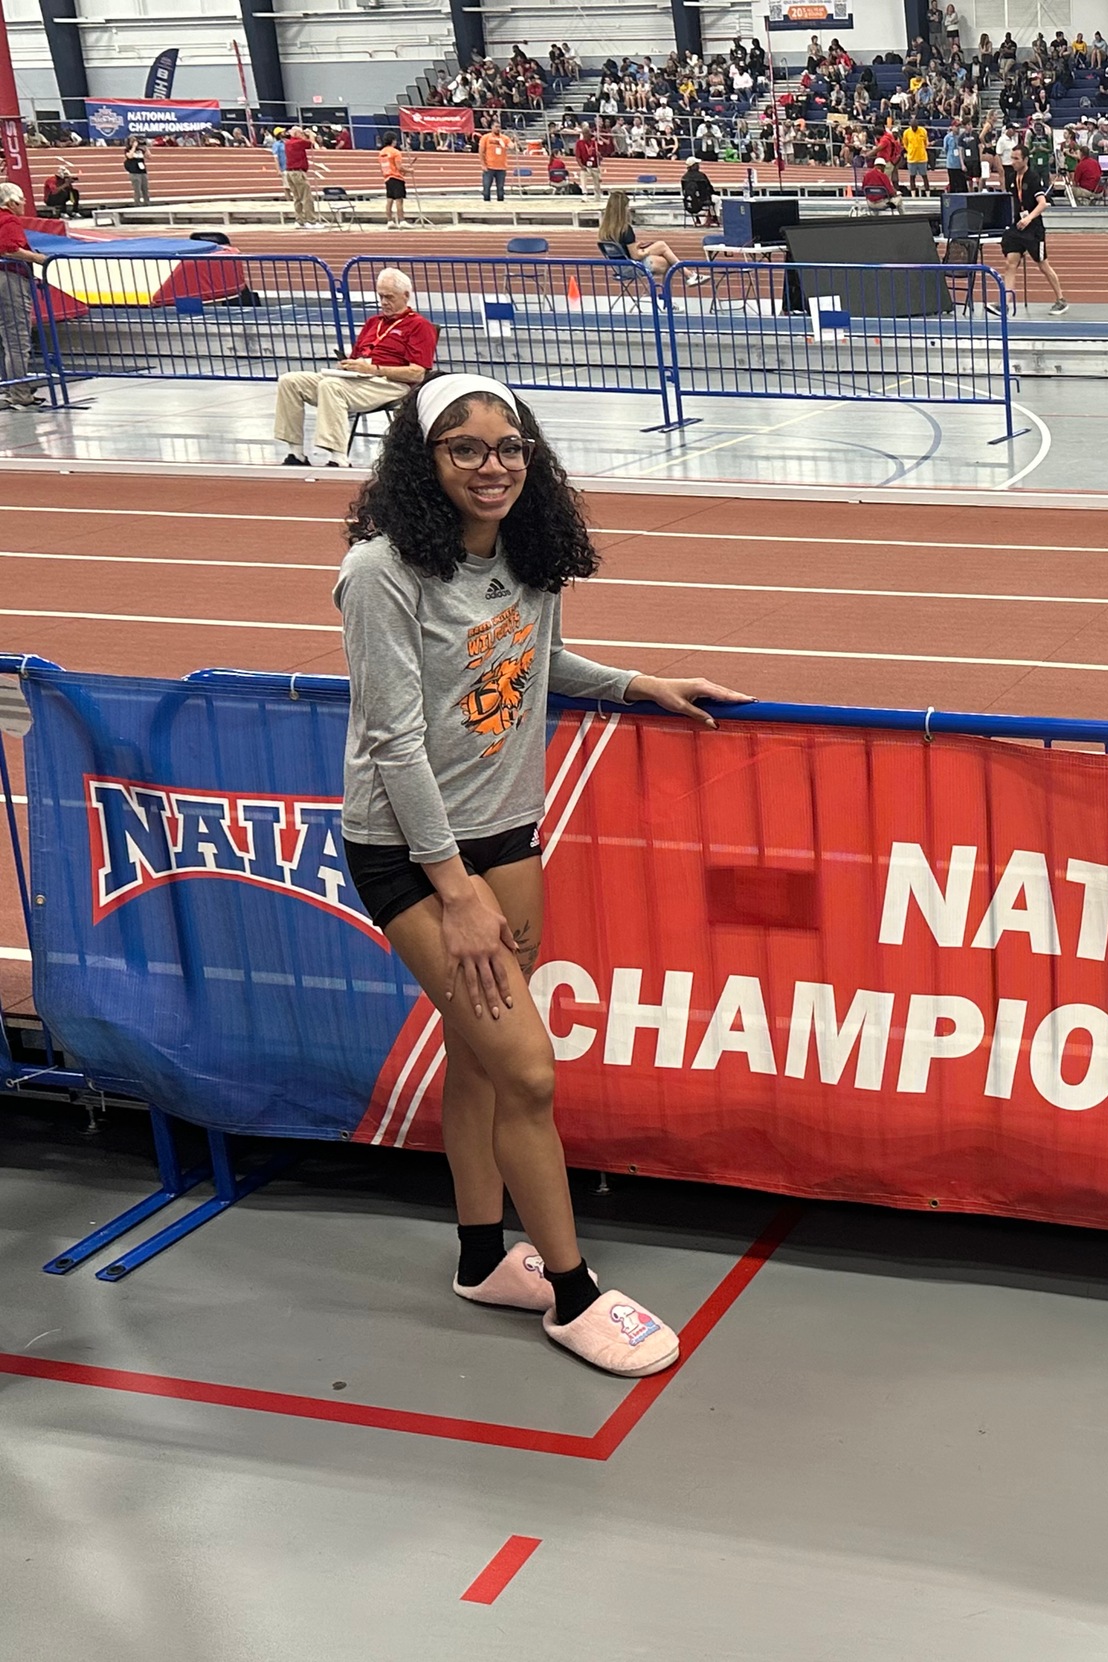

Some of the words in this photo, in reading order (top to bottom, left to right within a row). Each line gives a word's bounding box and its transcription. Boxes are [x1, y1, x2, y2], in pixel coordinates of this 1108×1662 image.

[127, 111, 177, 121] NATIONAL
[128, 122, 212, 132] CHAMPIONSHIPS
[485, 589, 511, 600] adidas
[90, 781, 378, 930] NAIA
